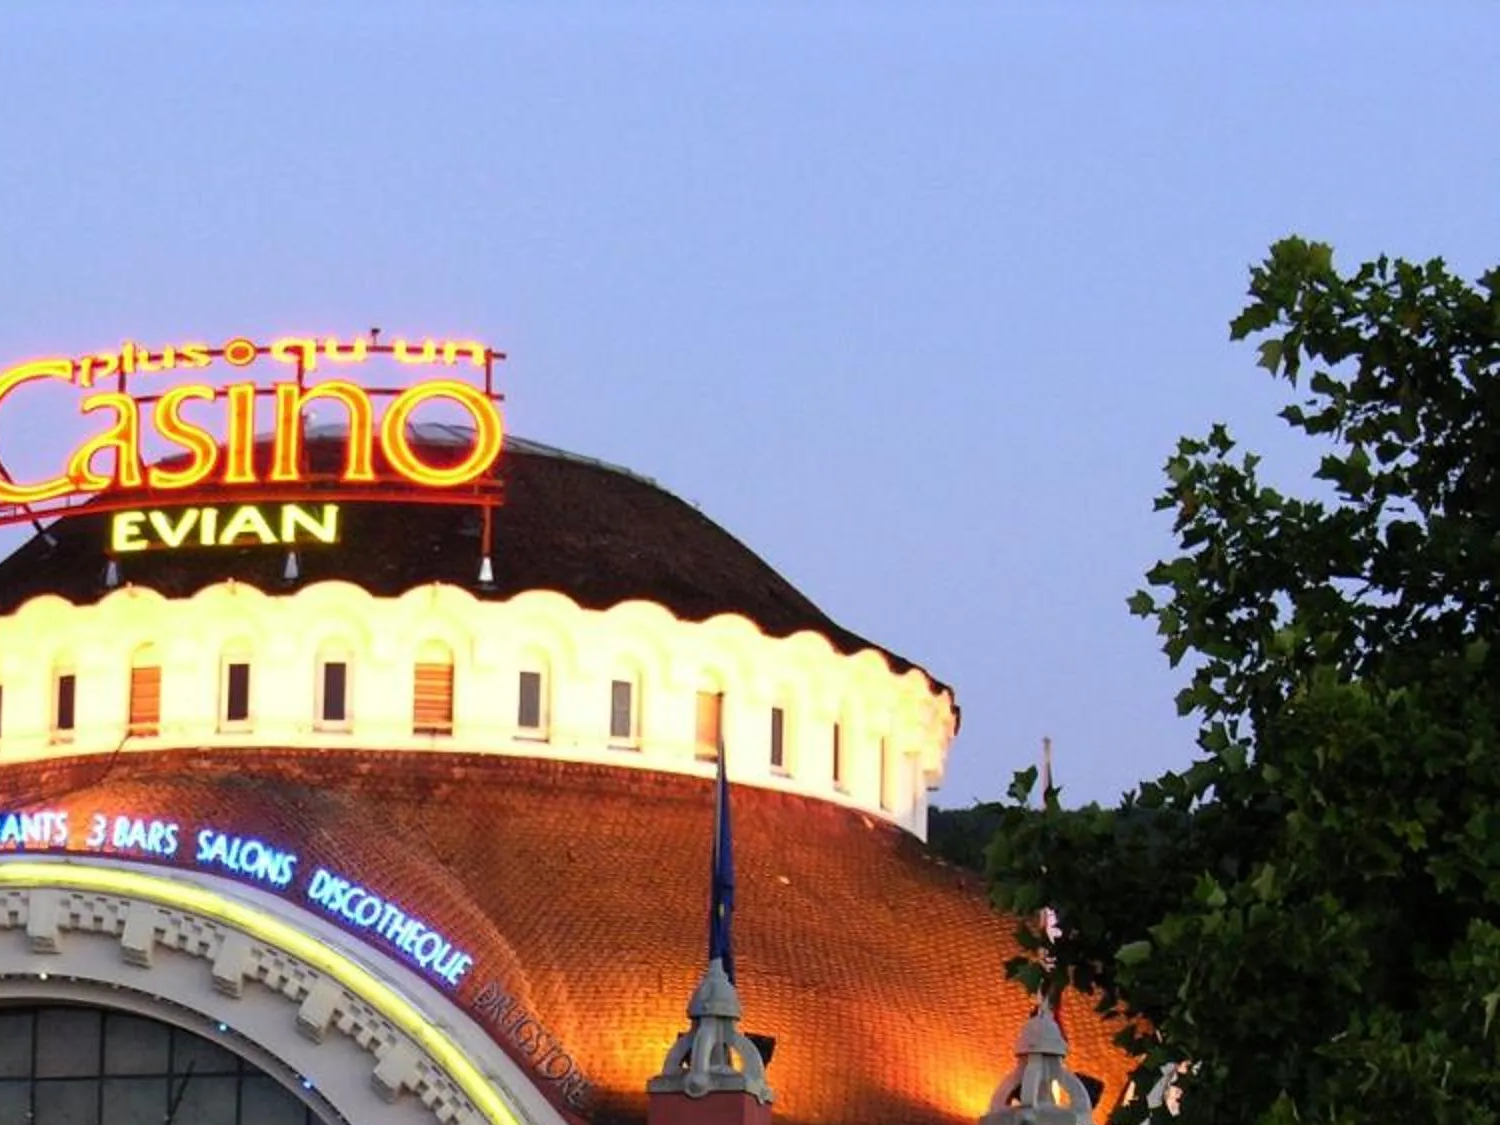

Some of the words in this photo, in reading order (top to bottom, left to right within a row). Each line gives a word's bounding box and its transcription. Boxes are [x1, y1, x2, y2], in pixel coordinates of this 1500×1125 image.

[78, 341, 212, 387] plus
[111, 504, 339, 552] EVIAN
[87, 817, 107, 847] 3
[111, 817, 178, 855] BARS
[196, 829, 297, 885] SALONS
[308, 868, 473, 986] DISCOTHEQUE
